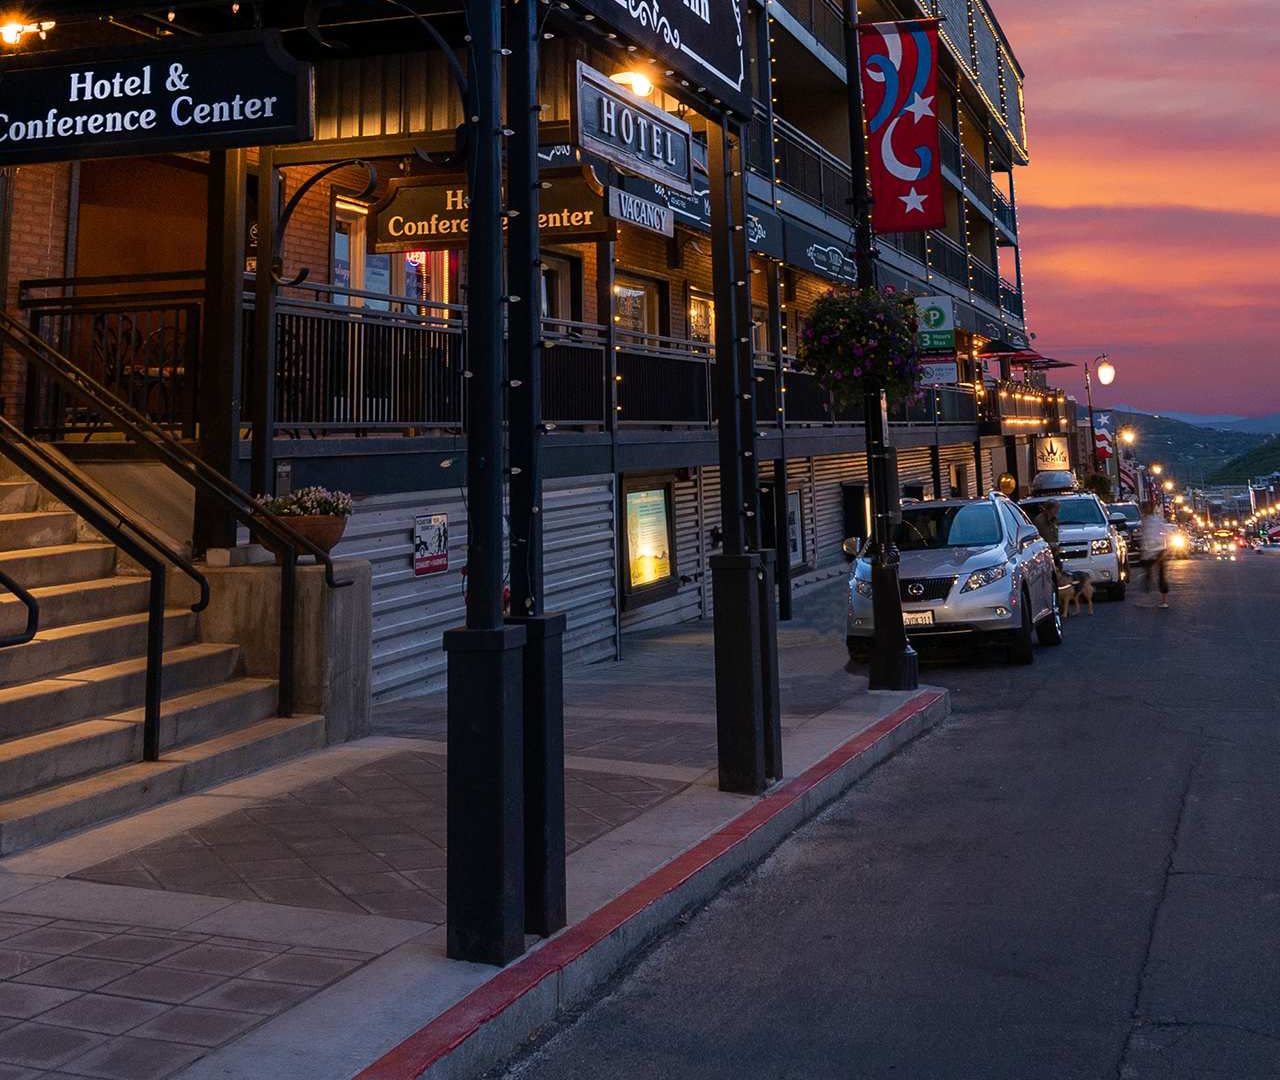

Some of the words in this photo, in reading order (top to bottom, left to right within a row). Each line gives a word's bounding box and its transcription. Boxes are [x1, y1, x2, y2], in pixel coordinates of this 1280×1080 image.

[69, 65, 152, 102] Hotel
[165, 62, 190, 92] &
[170, 94, 277, 127] Center
[601, 96, 677, 166] HOTEL
[536, 208, 594, 228] enter
[620, 193, 667, 231] VACANCY
